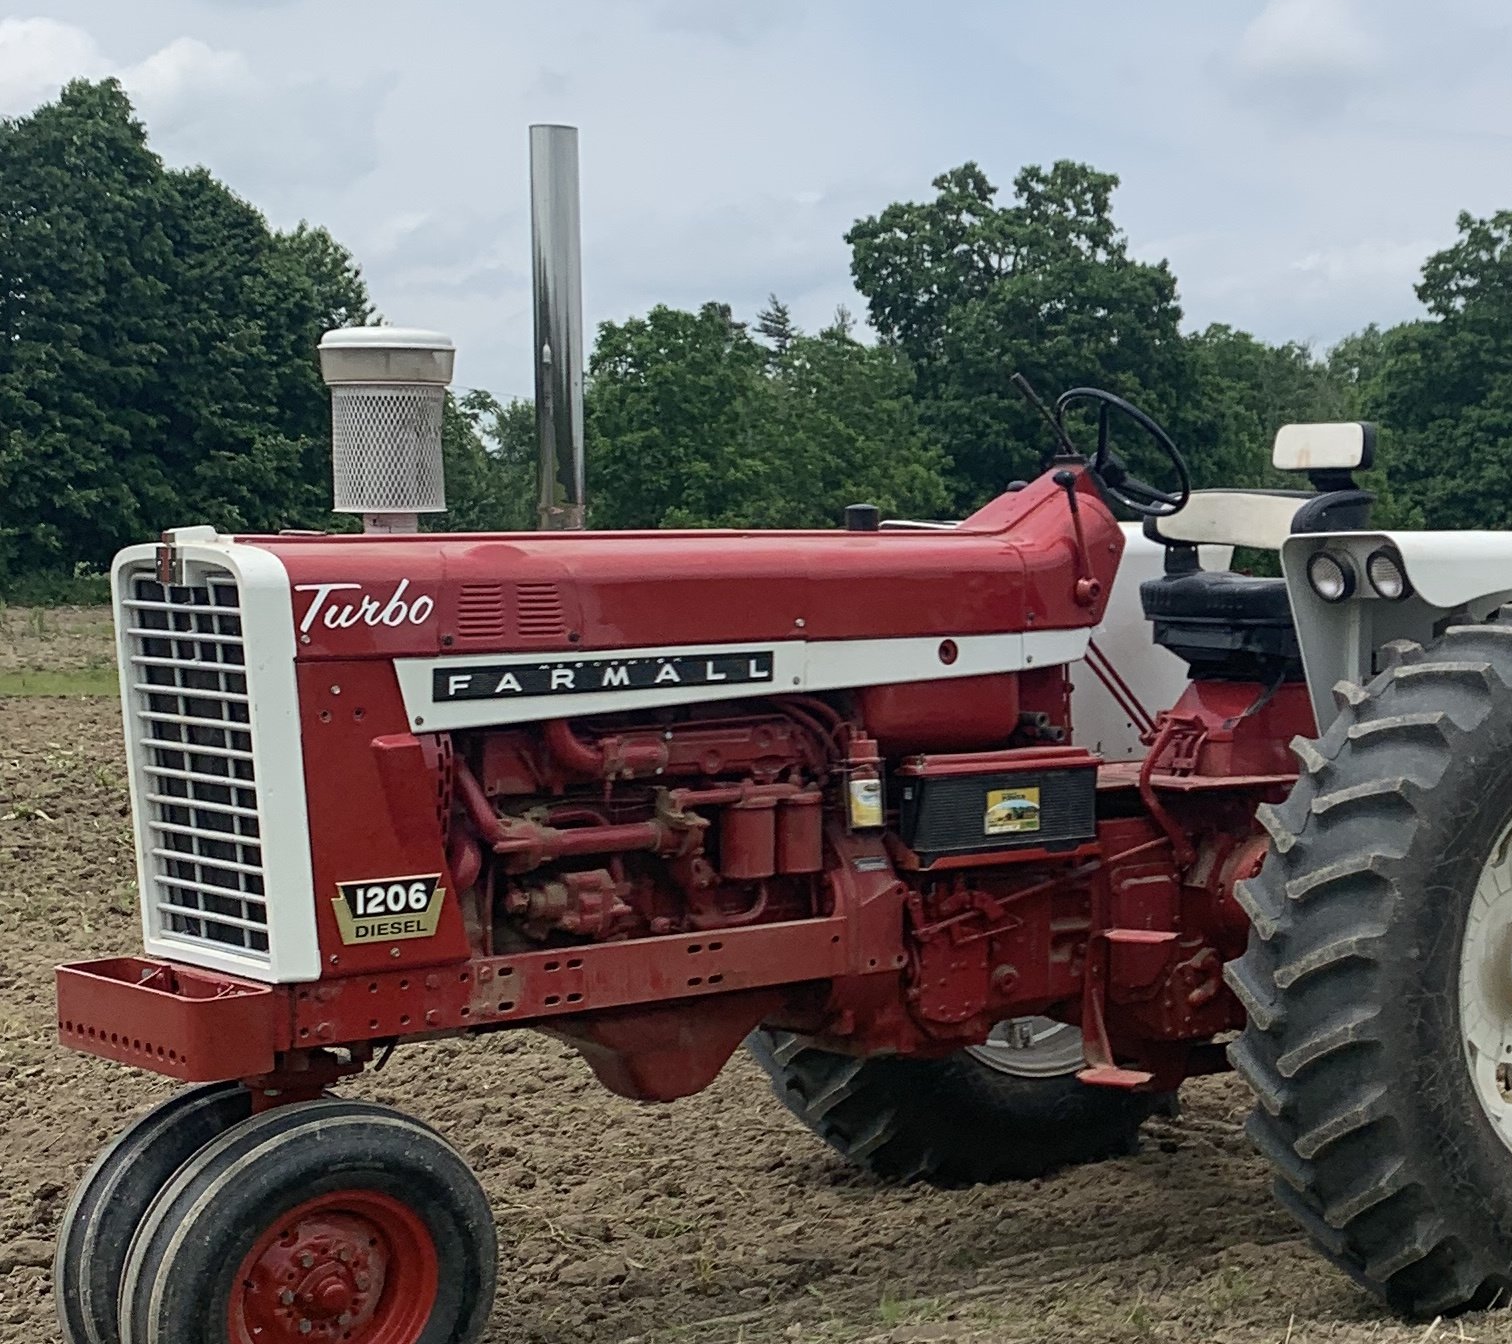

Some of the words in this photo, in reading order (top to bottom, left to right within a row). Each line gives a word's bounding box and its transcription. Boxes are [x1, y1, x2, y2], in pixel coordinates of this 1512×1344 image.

[294, 578, 434, 633] Turbo
[449, 659, 769, 696] FARMALL
[356, 882, 428, 915] 1206
[355, 920, 427, 938] DIESEL
